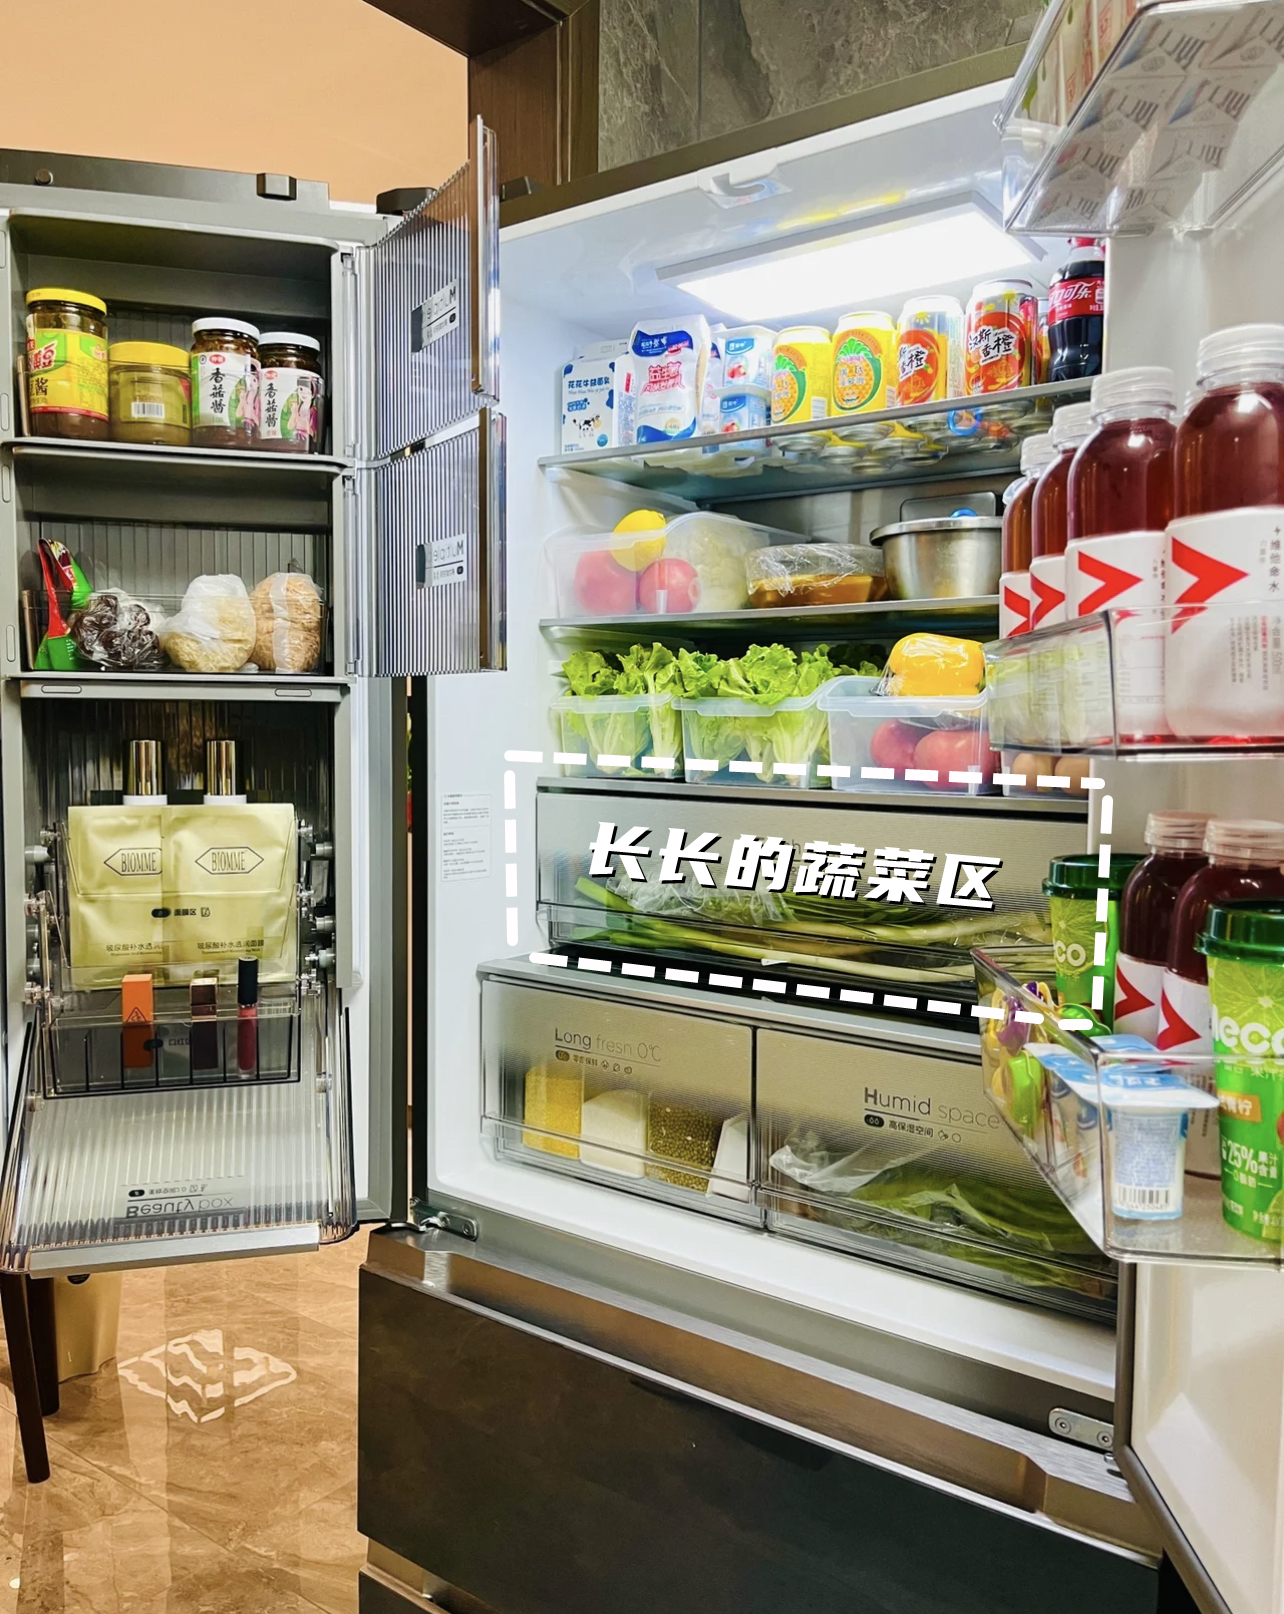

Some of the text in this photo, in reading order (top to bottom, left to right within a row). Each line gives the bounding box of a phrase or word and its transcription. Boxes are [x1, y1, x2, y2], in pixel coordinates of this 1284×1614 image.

[1268, 539, 1282, 593] 维他命水
[554, 1027, 592, 1050] Long
[595, 1034, 633, 1056] fresh
[864, 1087, 1000, 1131] Humid space
[889, 1120, 934, 1138] 高保湿空间
[1227, 1140, 1258, 1174] 25%
